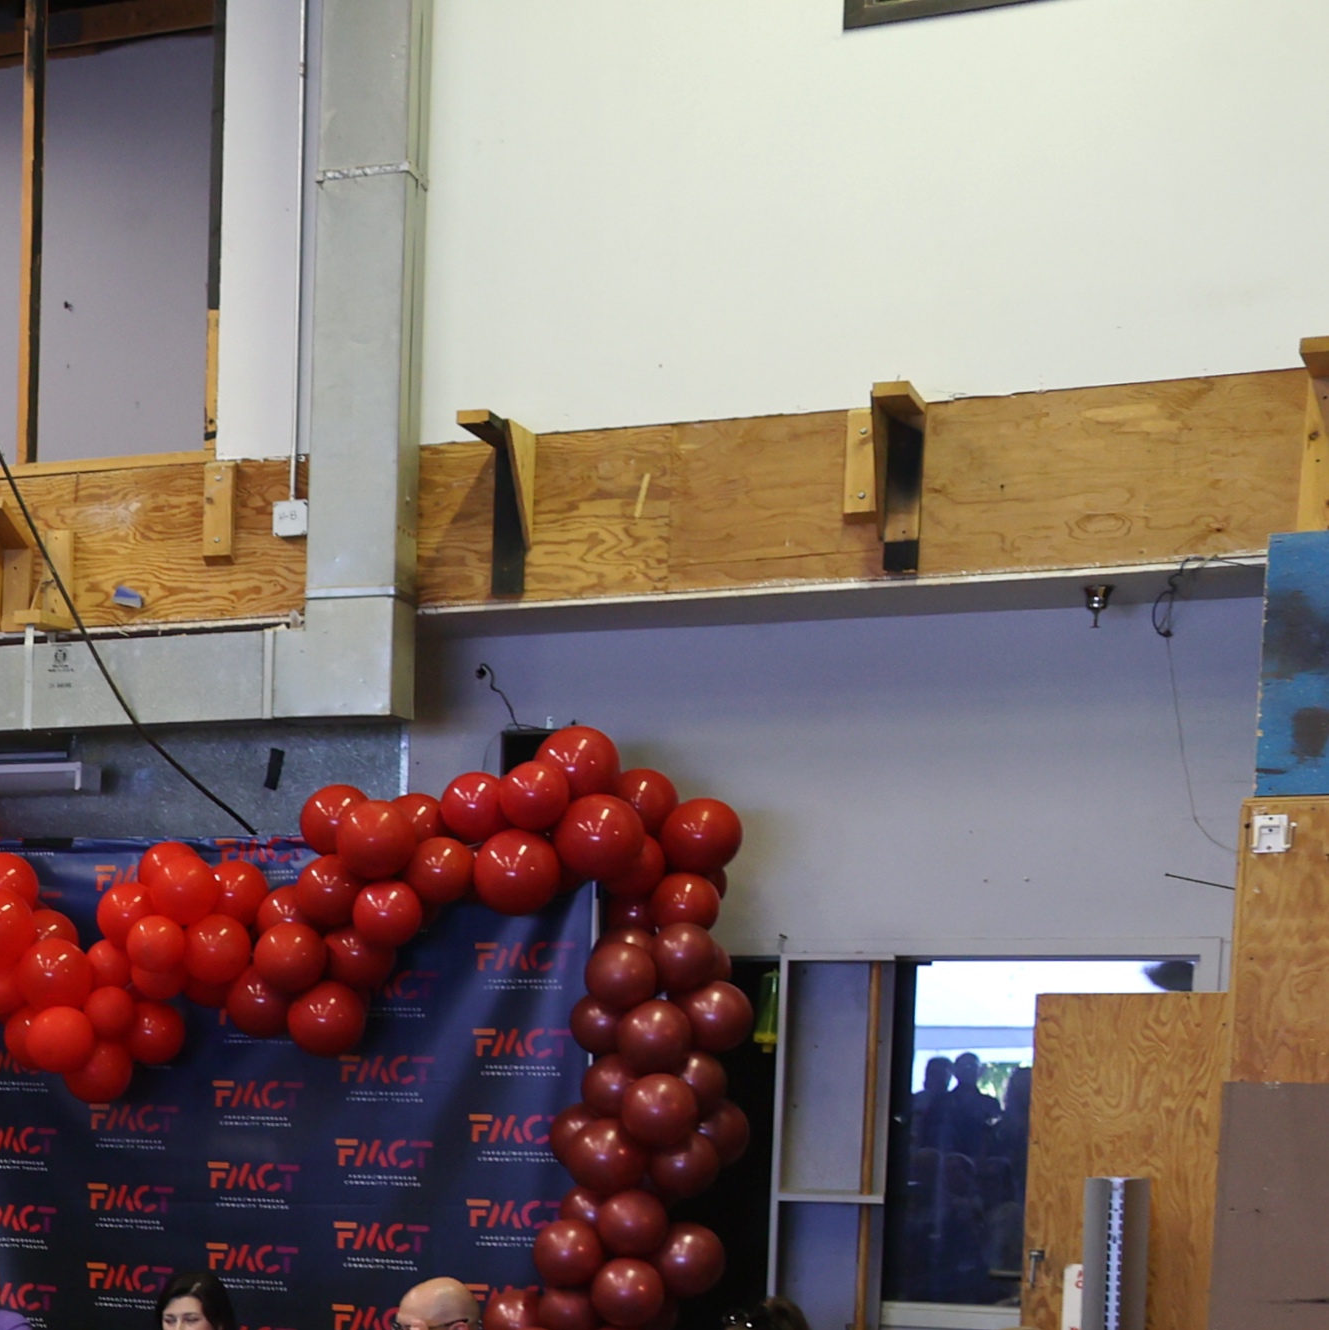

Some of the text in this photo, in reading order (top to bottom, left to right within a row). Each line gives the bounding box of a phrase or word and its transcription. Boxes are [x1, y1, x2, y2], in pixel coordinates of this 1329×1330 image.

[472, 1028, 571, 1058] FMCT
[339, 1055, 435, 1085] FMCT
[212, 1080, 305, 1110] FMCT
[89, 1103, 179, 1133] FMCT
[335, 1138, 433, 1169] FMCT
[207, 1161, 300, 1193] FMCT
[87, 1182, 174, 1214] FMCT
[333, 1221, 430, 1253] FMCT
[206, 1242, 299, 1274] FMCT
